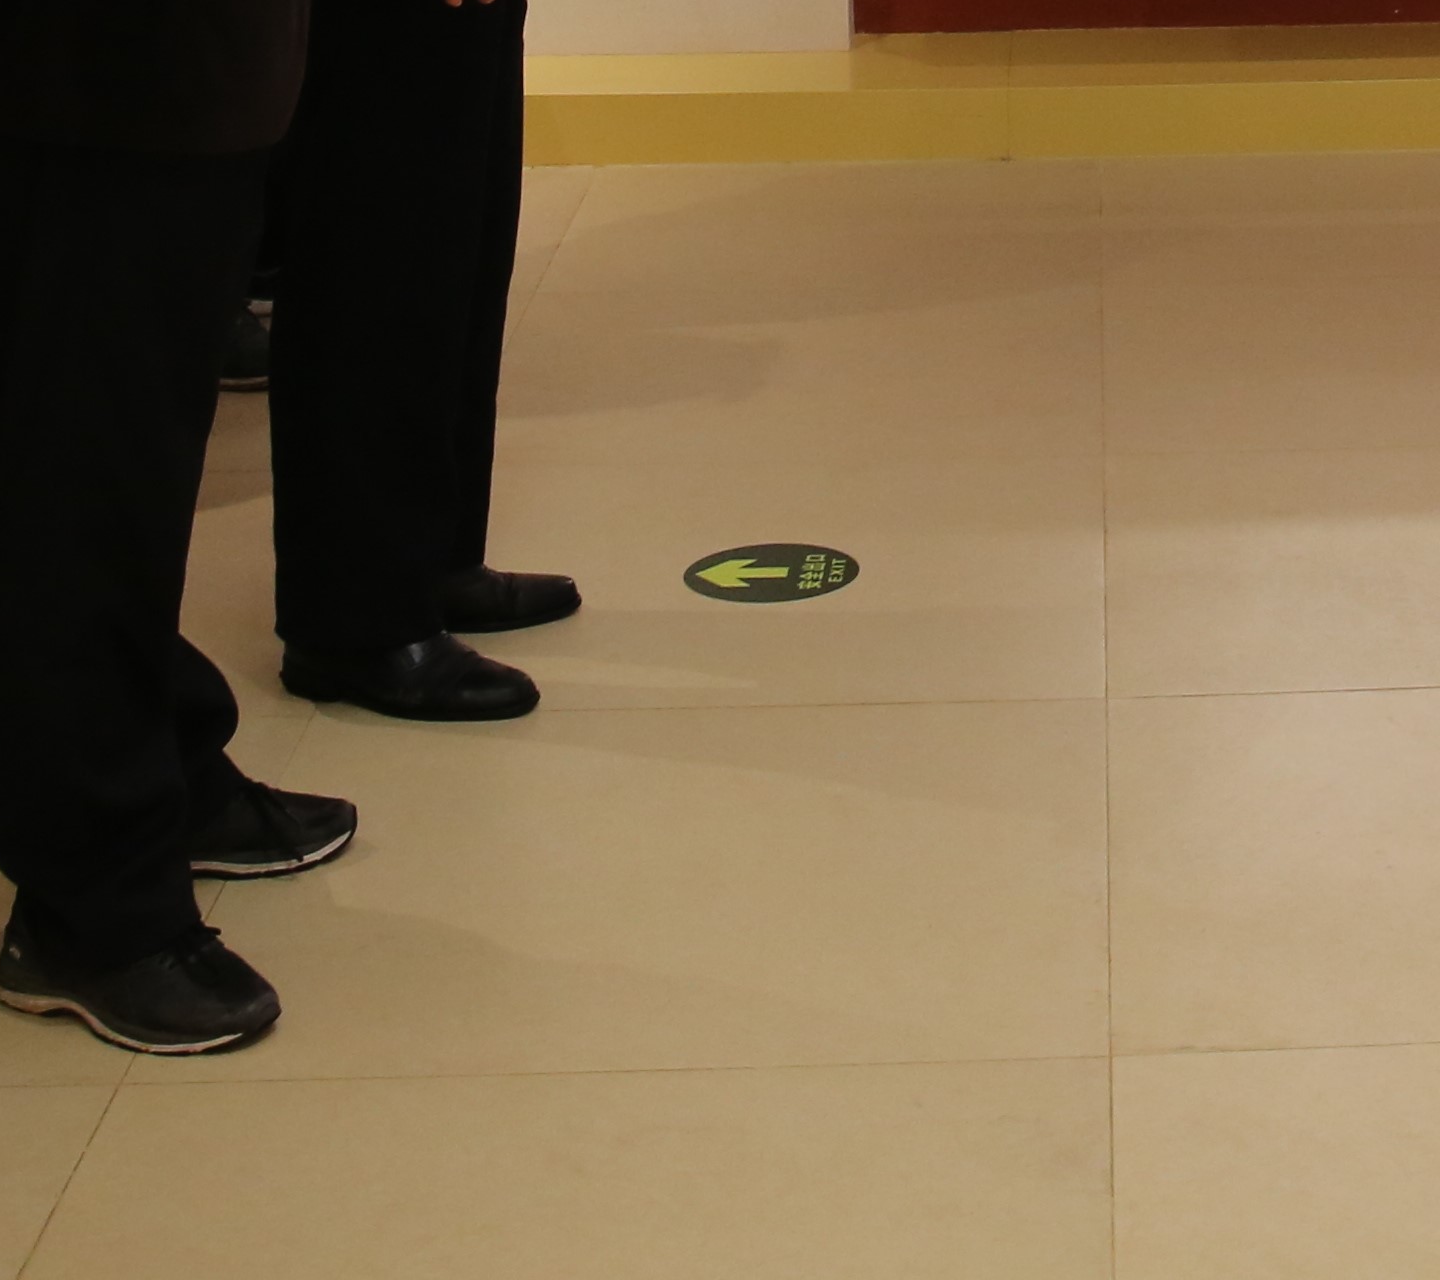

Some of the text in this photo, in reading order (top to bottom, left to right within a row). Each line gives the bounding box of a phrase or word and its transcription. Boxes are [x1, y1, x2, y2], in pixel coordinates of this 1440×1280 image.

[797, 553, 828, 590] 安全出口
[828, 558, 847, 583] EXIT
